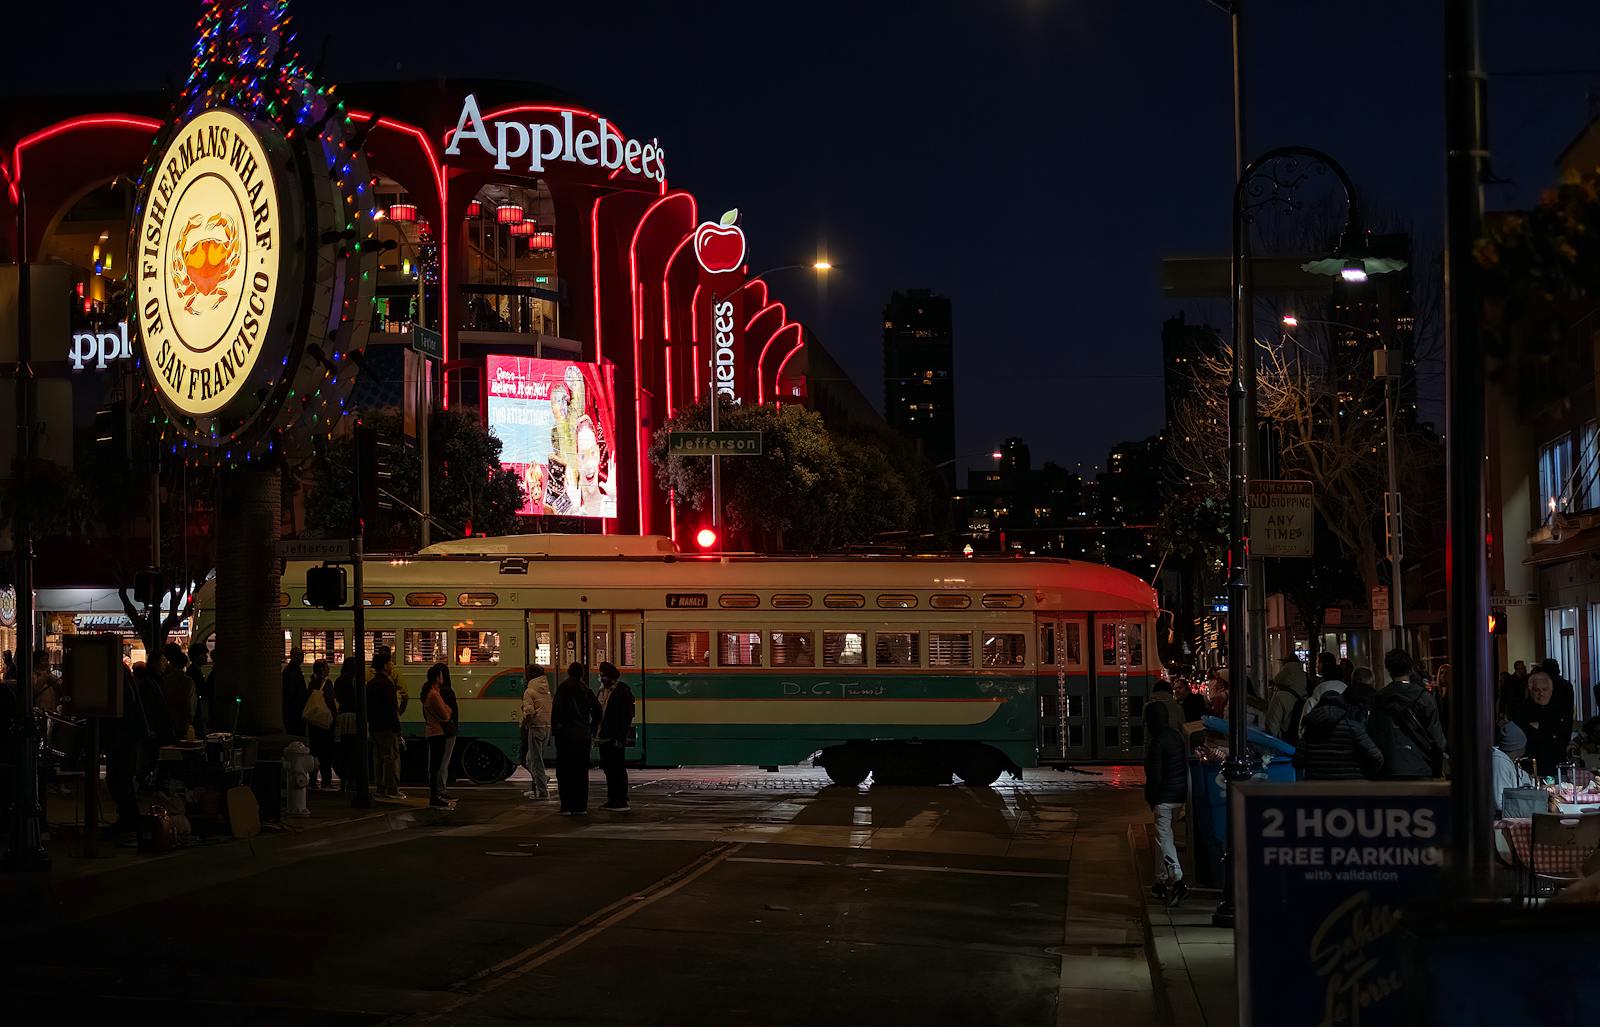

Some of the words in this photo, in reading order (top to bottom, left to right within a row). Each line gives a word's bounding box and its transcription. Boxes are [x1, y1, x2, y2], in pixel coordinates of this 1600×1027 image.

[445, 93, 665, 182] Applebee's
[143, 125, 229, 281] FISHERMANS
[229, 133, 272, 251] WHARF
[144, 298, 163, 338] OF
[156, 339, 186, 393] SAN
[187, 272, 269, 401] FRANCISCO
[674, 437, 755, 449] Jefferson
[1249, 493, 1269, 508] NO
[1267, 514, 1295, 526] ANY
[281, 543, 344, 554] Jefferson
[1261, 807, 1285, 838] 2
[1296, 808, 1437, 839] HOURS
[1263, 847, 1326, 866] FREE
[1330, 846, 1443, 866] PARKING
[1305, 869, 1332, 881] with
[1335, 869, 1399, 881] validation
